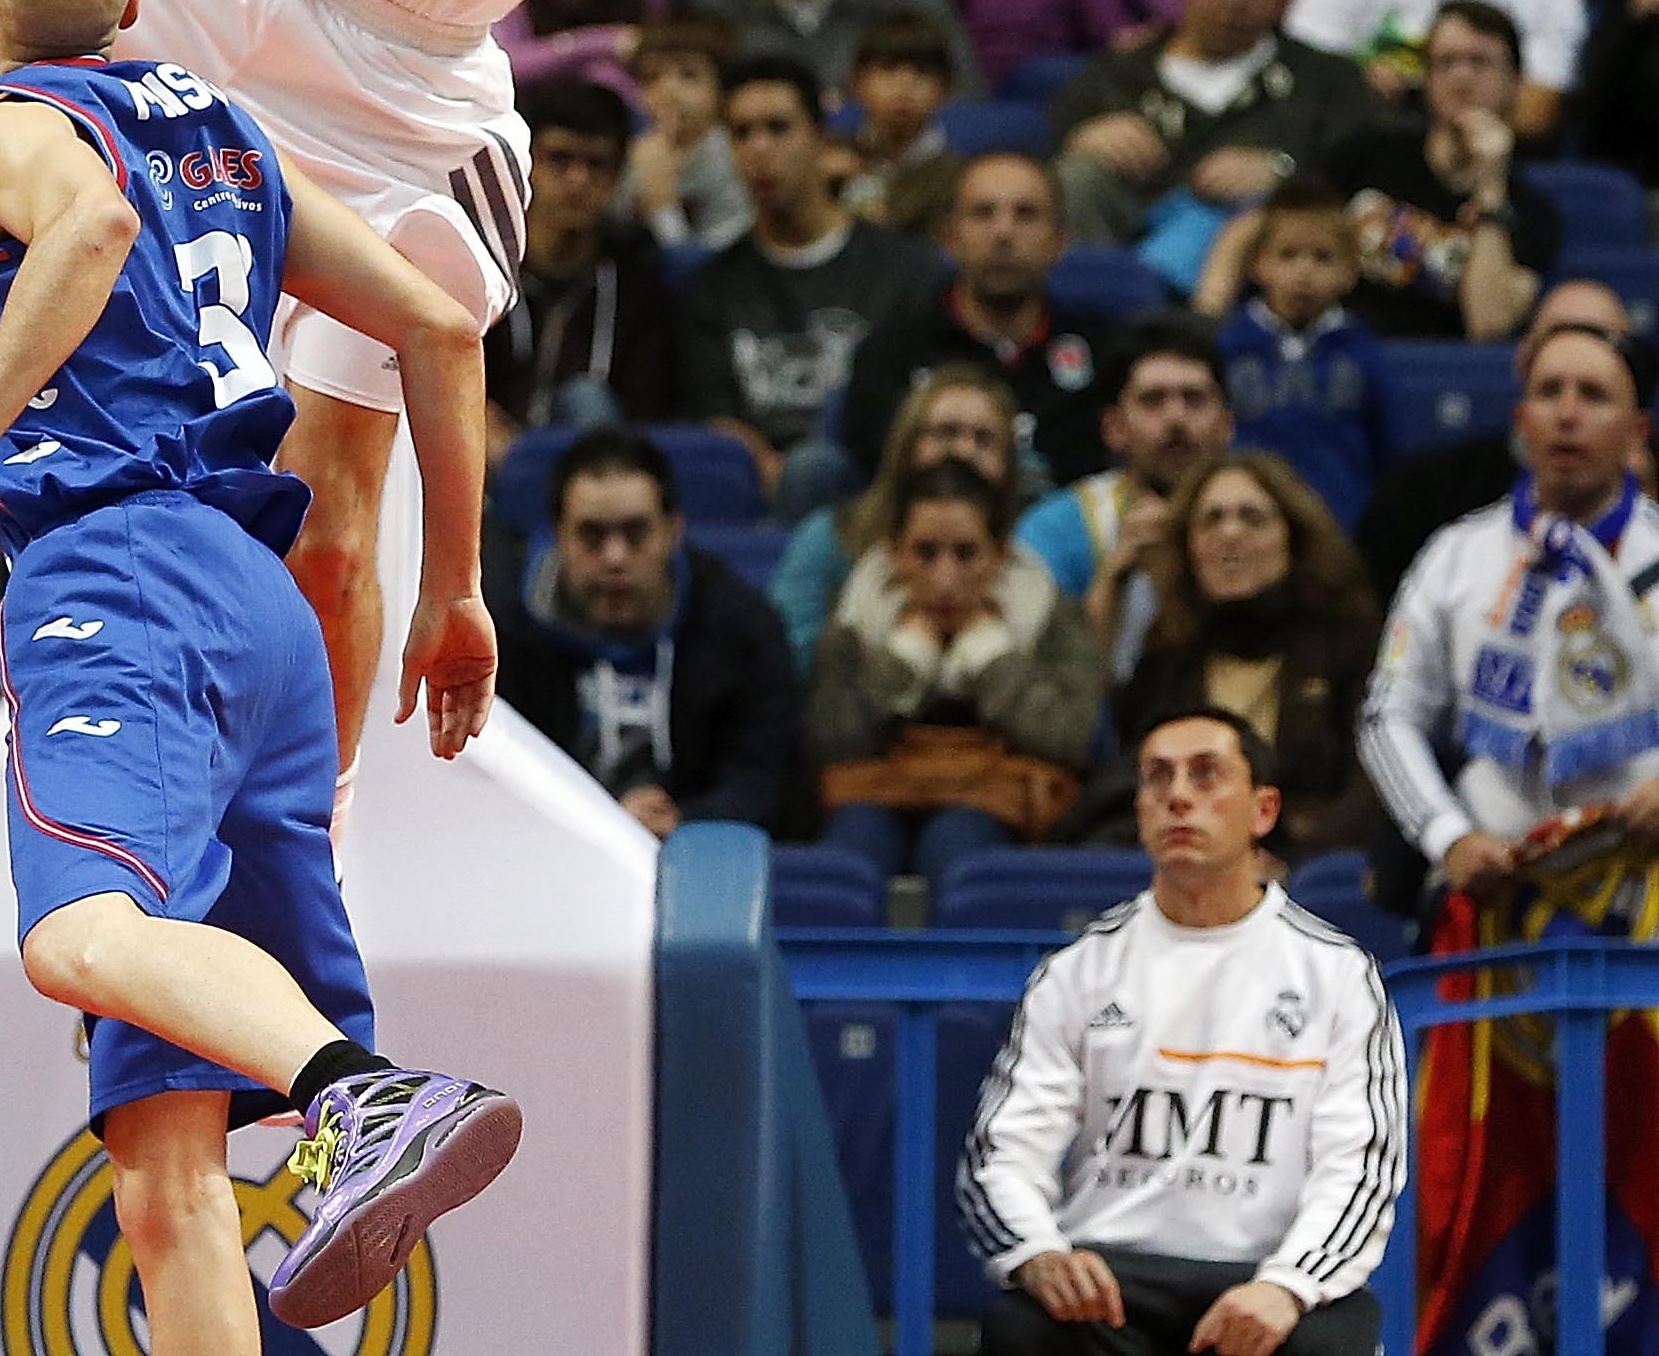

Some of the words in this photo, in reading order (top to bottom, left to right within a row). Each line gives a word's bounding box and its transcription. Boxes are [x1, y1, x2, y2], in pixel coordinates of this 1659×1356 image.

[173, 230, 278, 410] 3
[1103, 1088, 1294, 1164] MMT
[1096, 1167, 1260, 1195] SEROS
